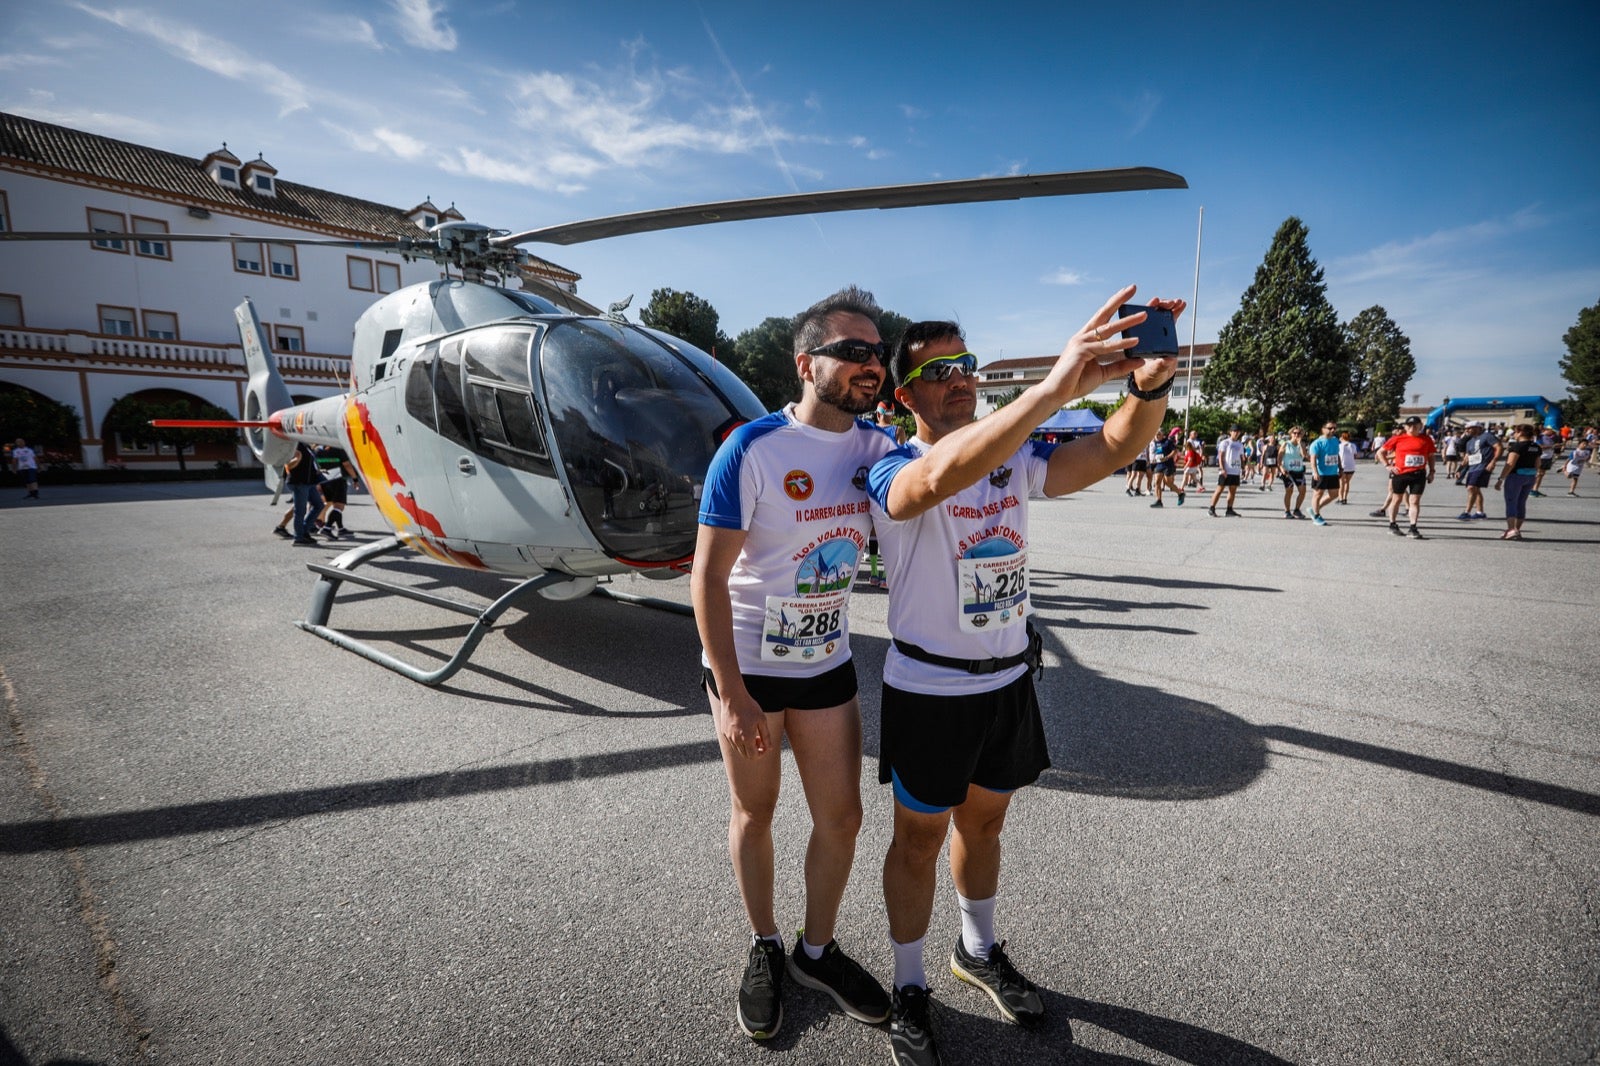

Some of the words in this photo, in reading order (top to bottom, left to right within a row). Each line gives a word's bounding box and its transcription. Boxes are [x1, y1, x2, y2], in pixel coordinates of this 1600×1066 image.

[796, 509, 802, 522] II
[837, 503, 855, 516] BASE
[995, 568, 1025, 600] 226
[799, 609, 840, 637] 288
